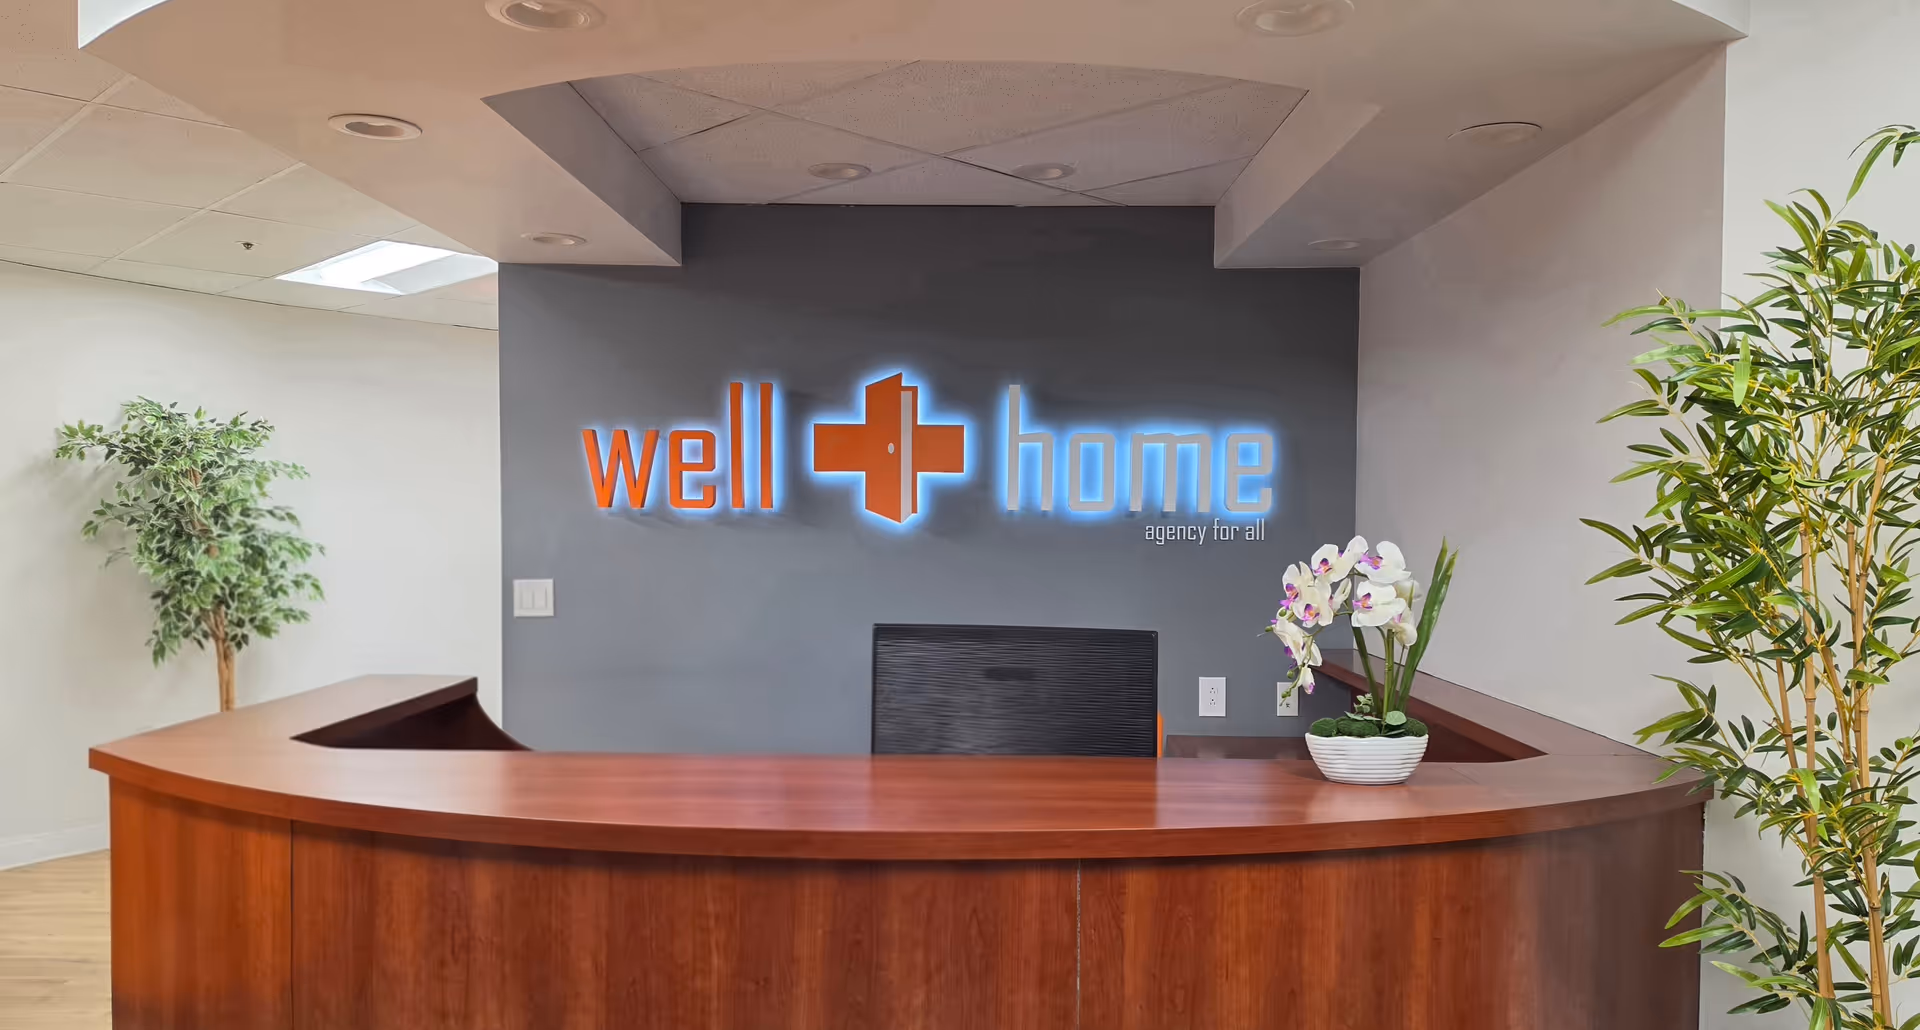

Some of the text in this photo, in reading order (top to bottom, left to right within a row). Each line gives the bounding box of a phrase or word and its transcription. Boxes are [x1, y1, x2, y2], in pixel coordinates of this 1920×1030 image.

[582, 381, 1273, 512] well home
[1145, 518, 1265, 545] agency for all
